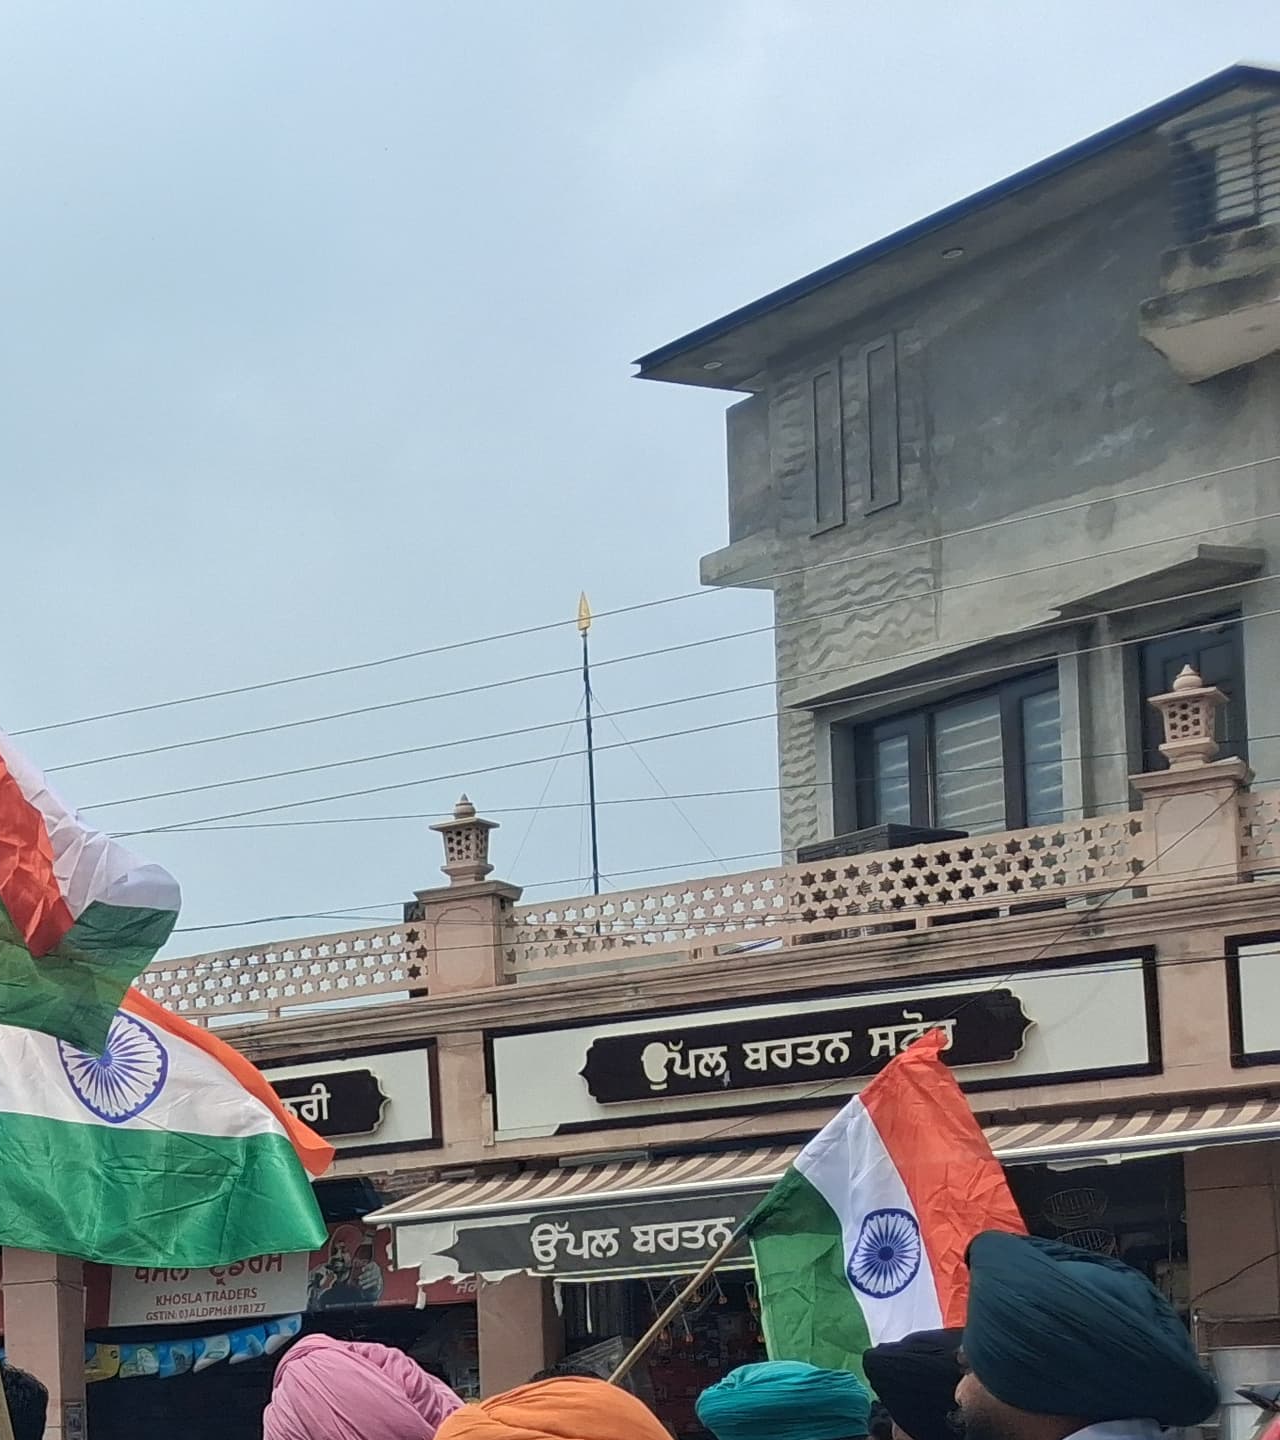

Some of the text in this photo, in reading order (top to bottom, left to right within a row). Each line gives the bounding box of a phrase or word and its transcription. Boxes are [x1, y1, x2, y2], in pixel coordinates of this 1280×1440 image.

[743, 1031, 852, 1071] ਬਰਤਨ
[530, 1216, 737, 1271] ਉੱਪਲ ਬਰਤਨ
[155, 1287, 258, 1306] KHOSLA TRADERS
